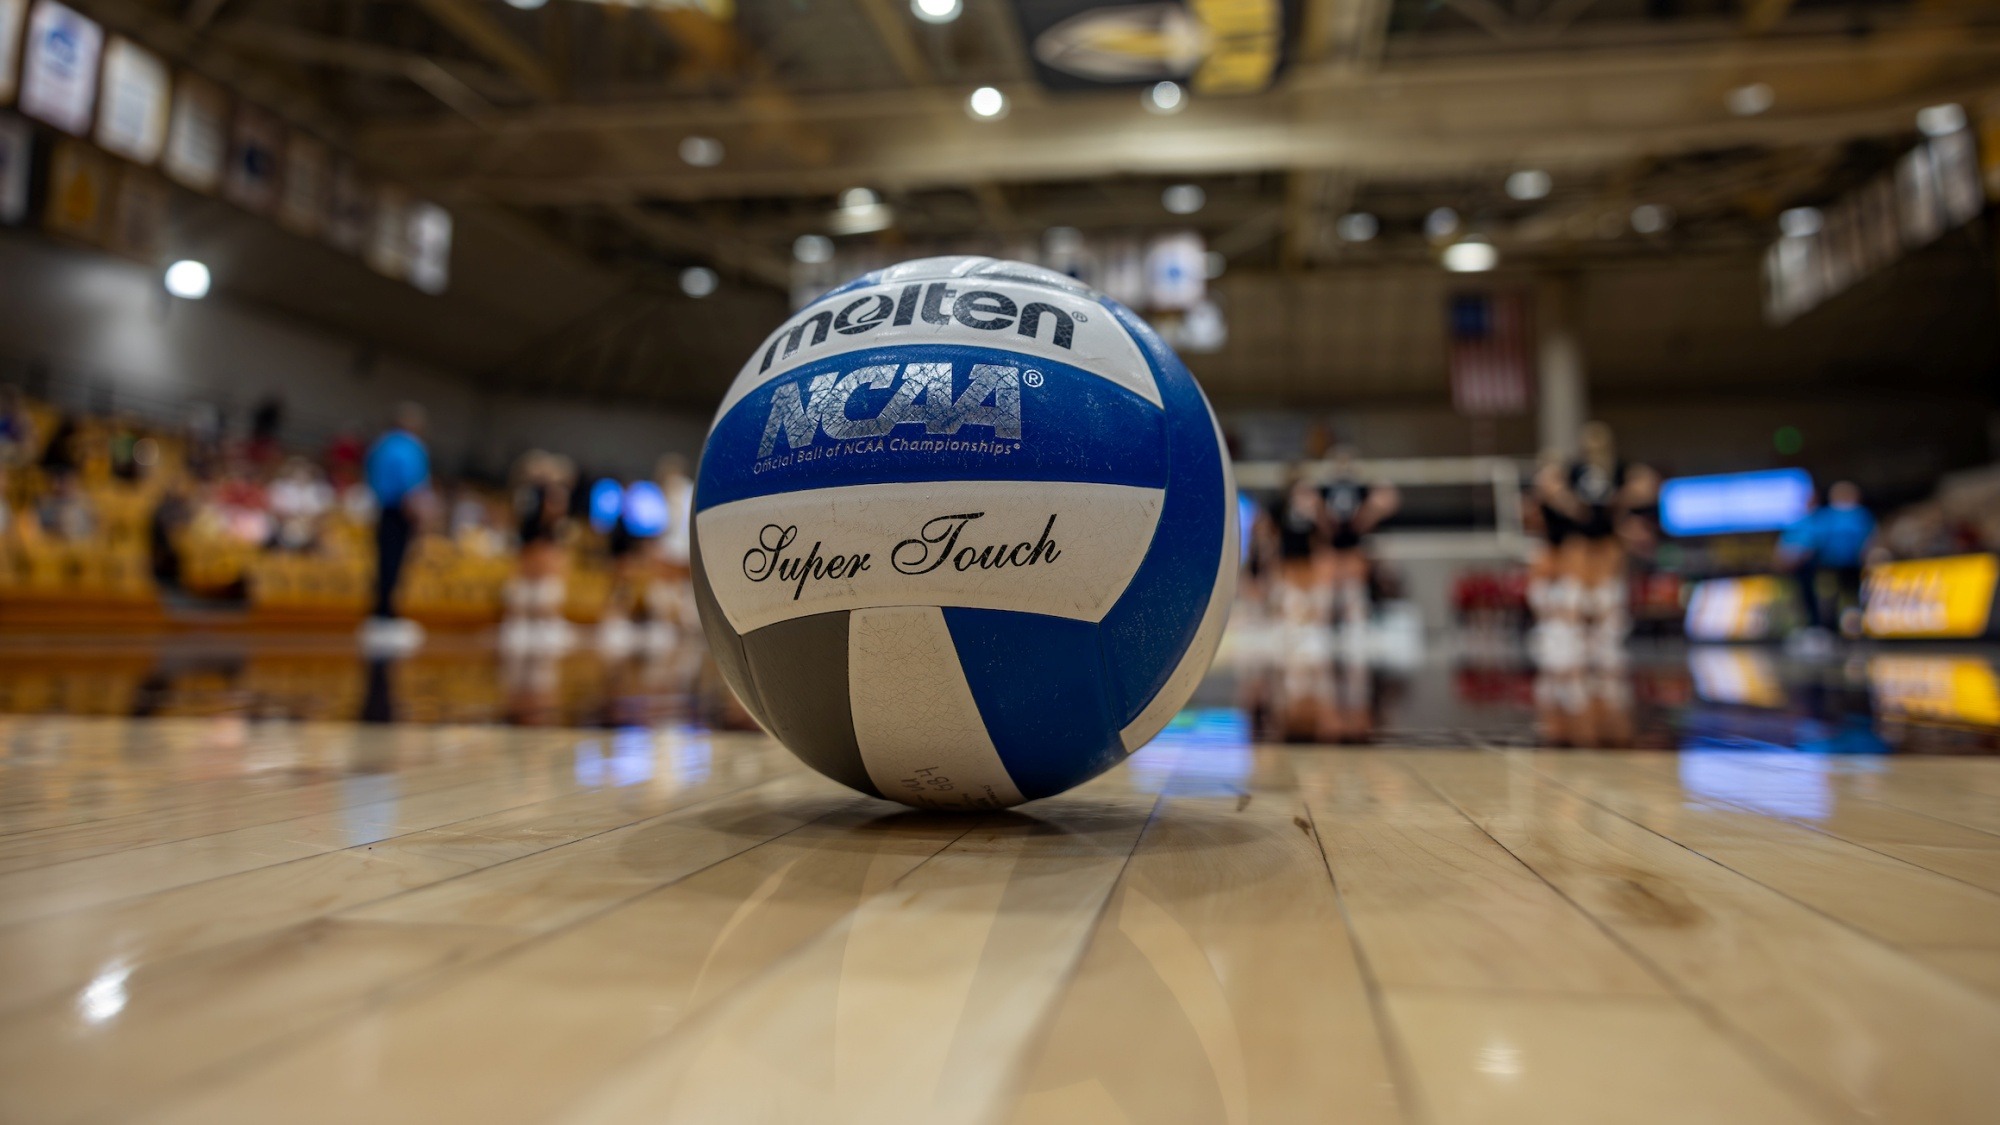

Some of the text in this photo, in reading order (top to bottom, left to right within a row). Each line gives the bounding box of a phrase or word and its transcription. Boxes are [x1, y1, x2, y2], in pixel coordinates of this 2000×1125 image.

[753, 453, 794, 475] Official
[797, 445, 822, 463] Ball
[825, 443, 841, 458] of
[843, 439, 885, 456] NCAA
[742, 512, 1061, 600] Super Touch
